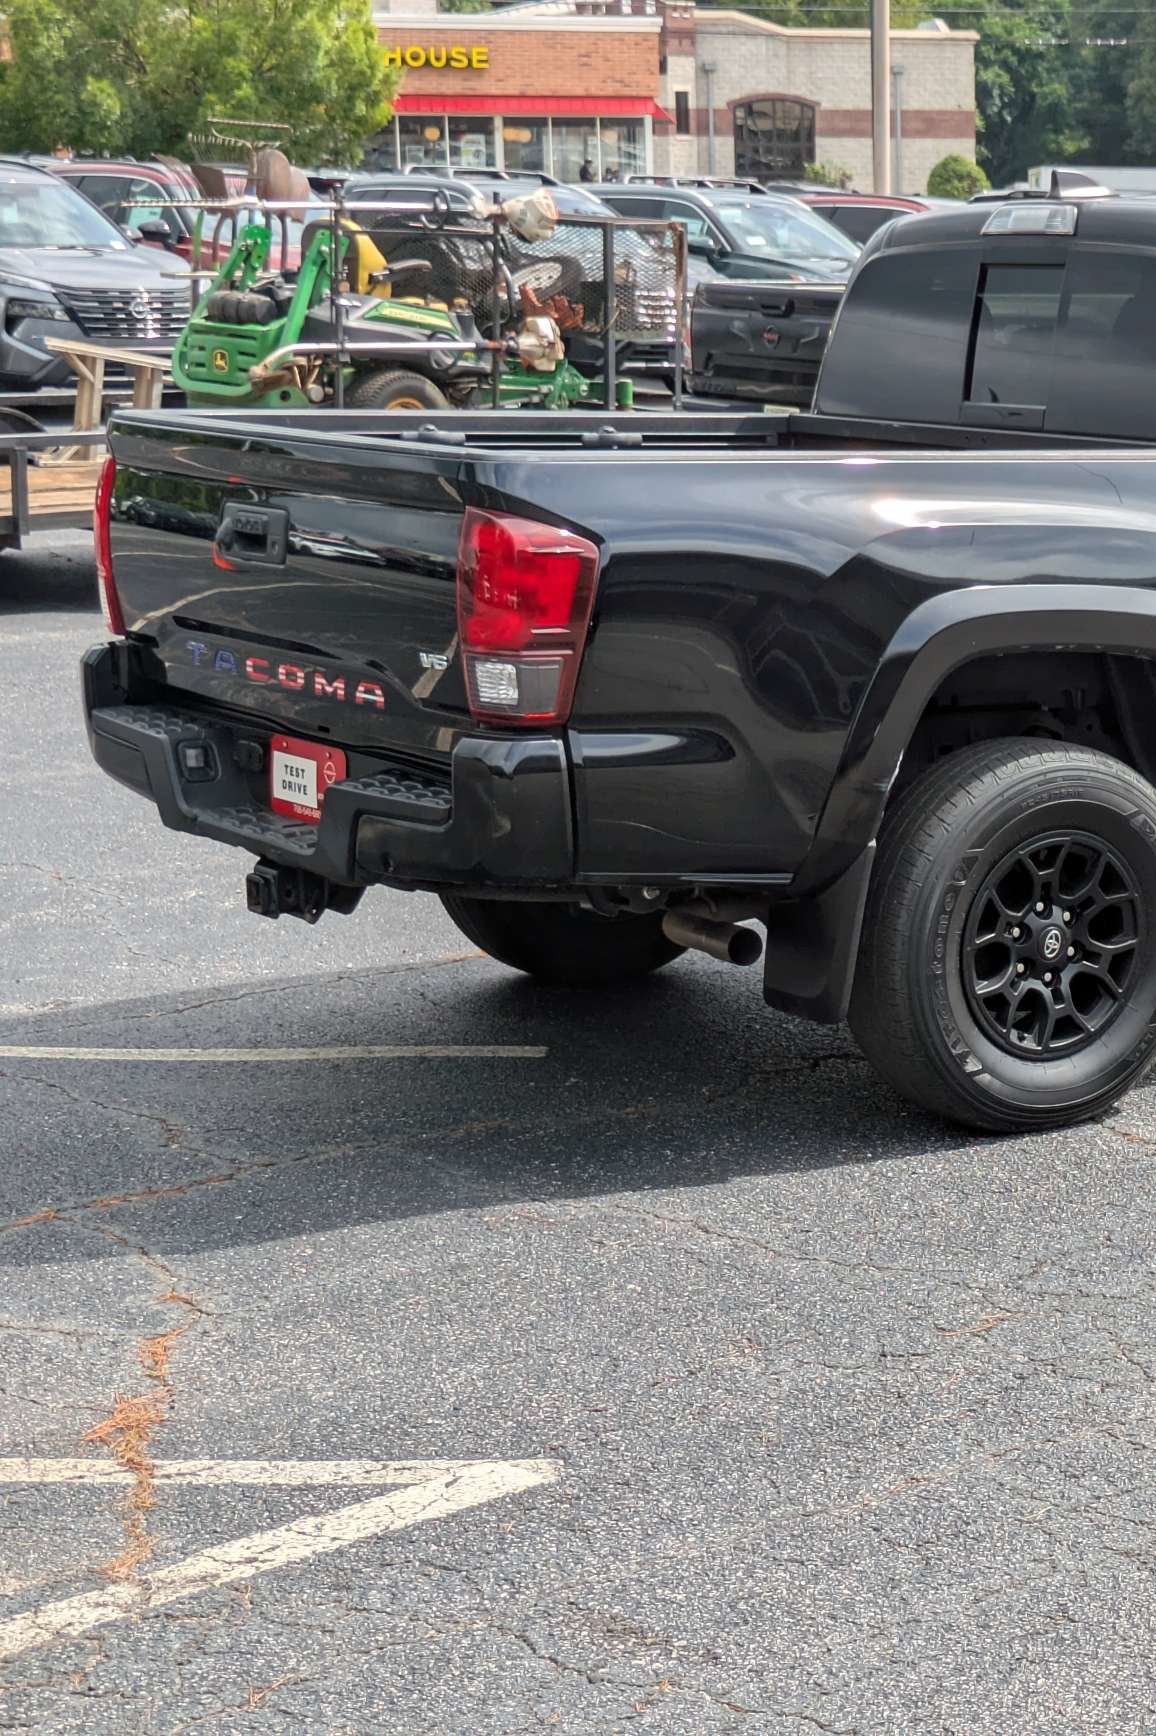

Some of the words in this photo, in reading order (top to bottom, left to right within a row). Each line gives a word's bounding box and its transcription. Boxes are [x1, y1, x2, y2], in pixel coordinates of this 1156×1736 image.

[384, 45, 489, 69] HOUSE
[419, 652, 448, 670] V6
[186, 640, 385, 709] TACOMA
[284, 764, 306, 779] TEST
[282, 780, 308, 796] DRIVE
